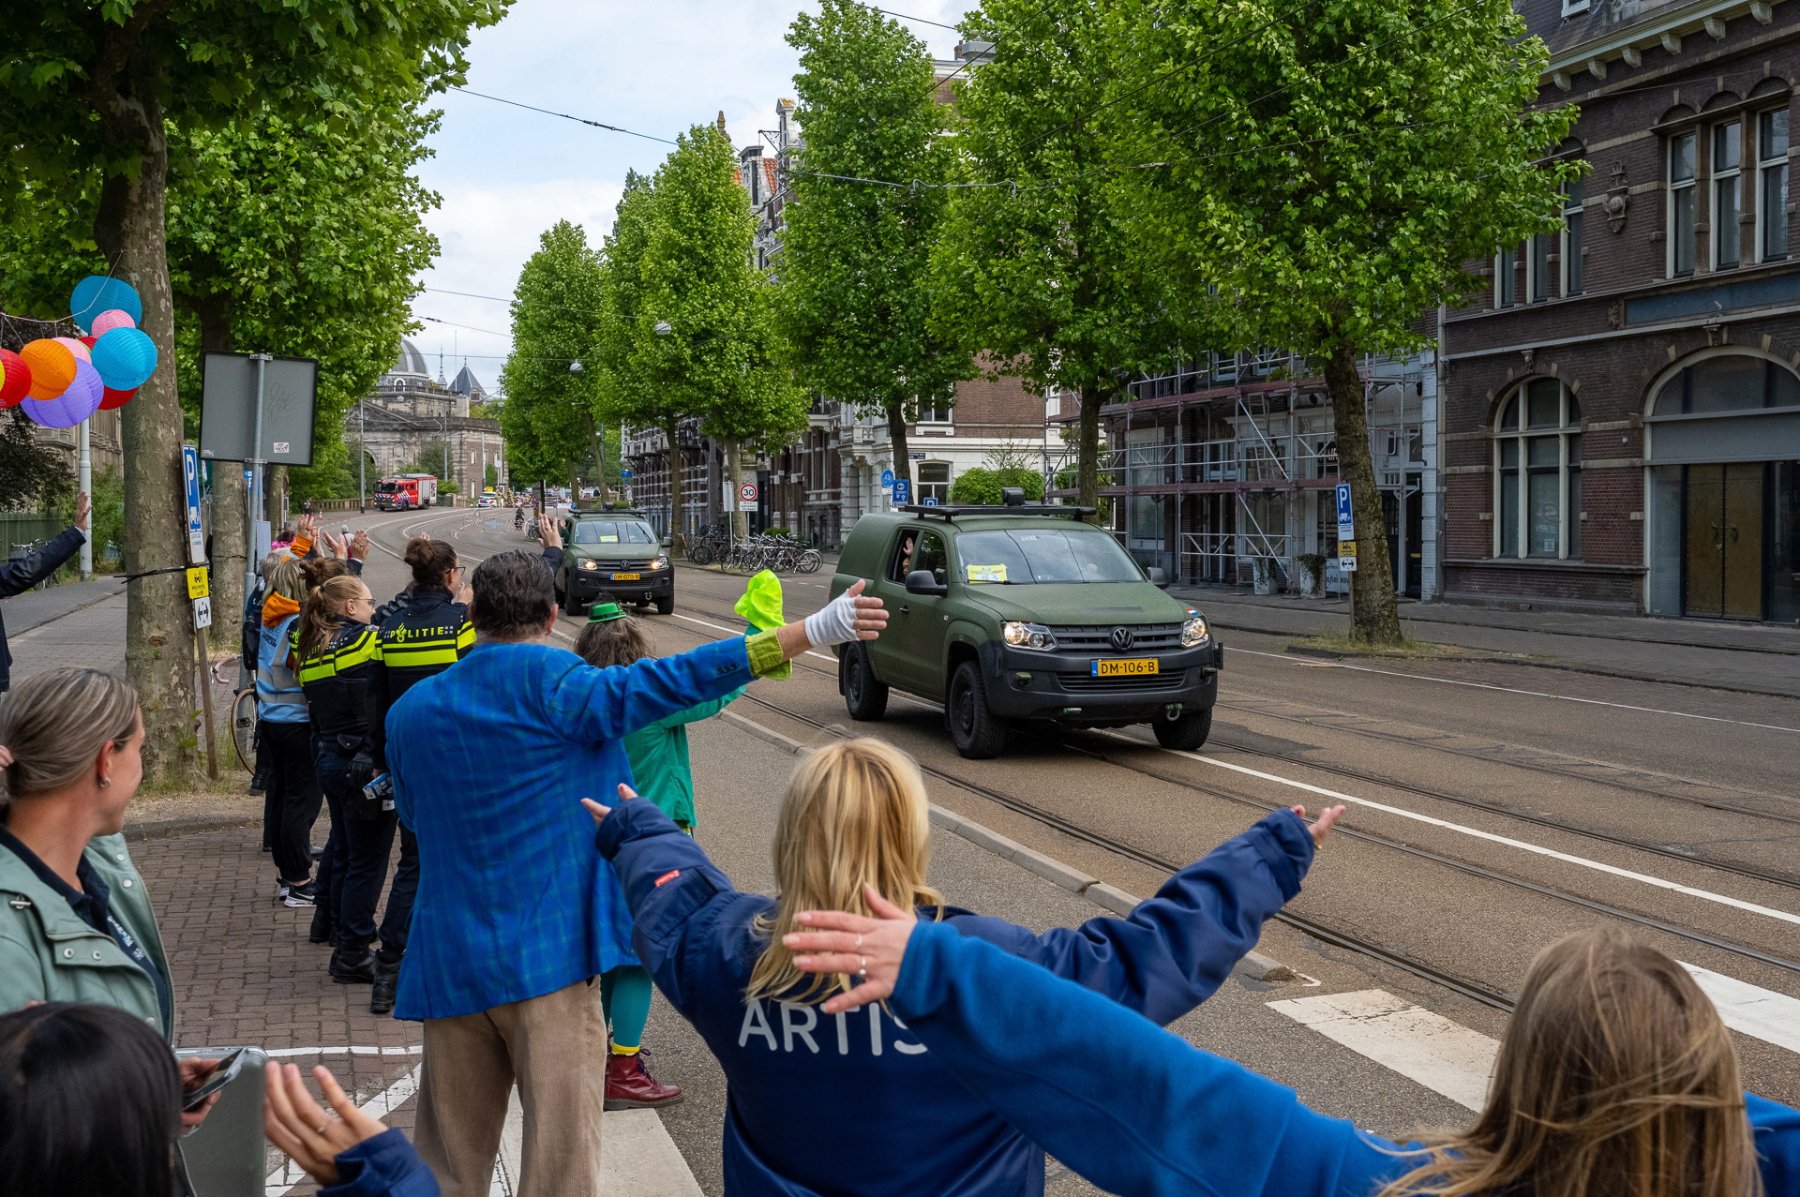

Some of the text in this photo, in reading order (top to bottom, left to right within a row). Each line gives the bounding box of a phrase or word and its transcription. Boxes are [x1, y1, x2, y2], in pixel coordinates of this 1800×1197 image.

[186, 454, 195, 496] P
[743, 488, 755, 497] 30
[1339, 487, 1348, 509] P
[1101, 661, 1155, 674] DM-106-B
